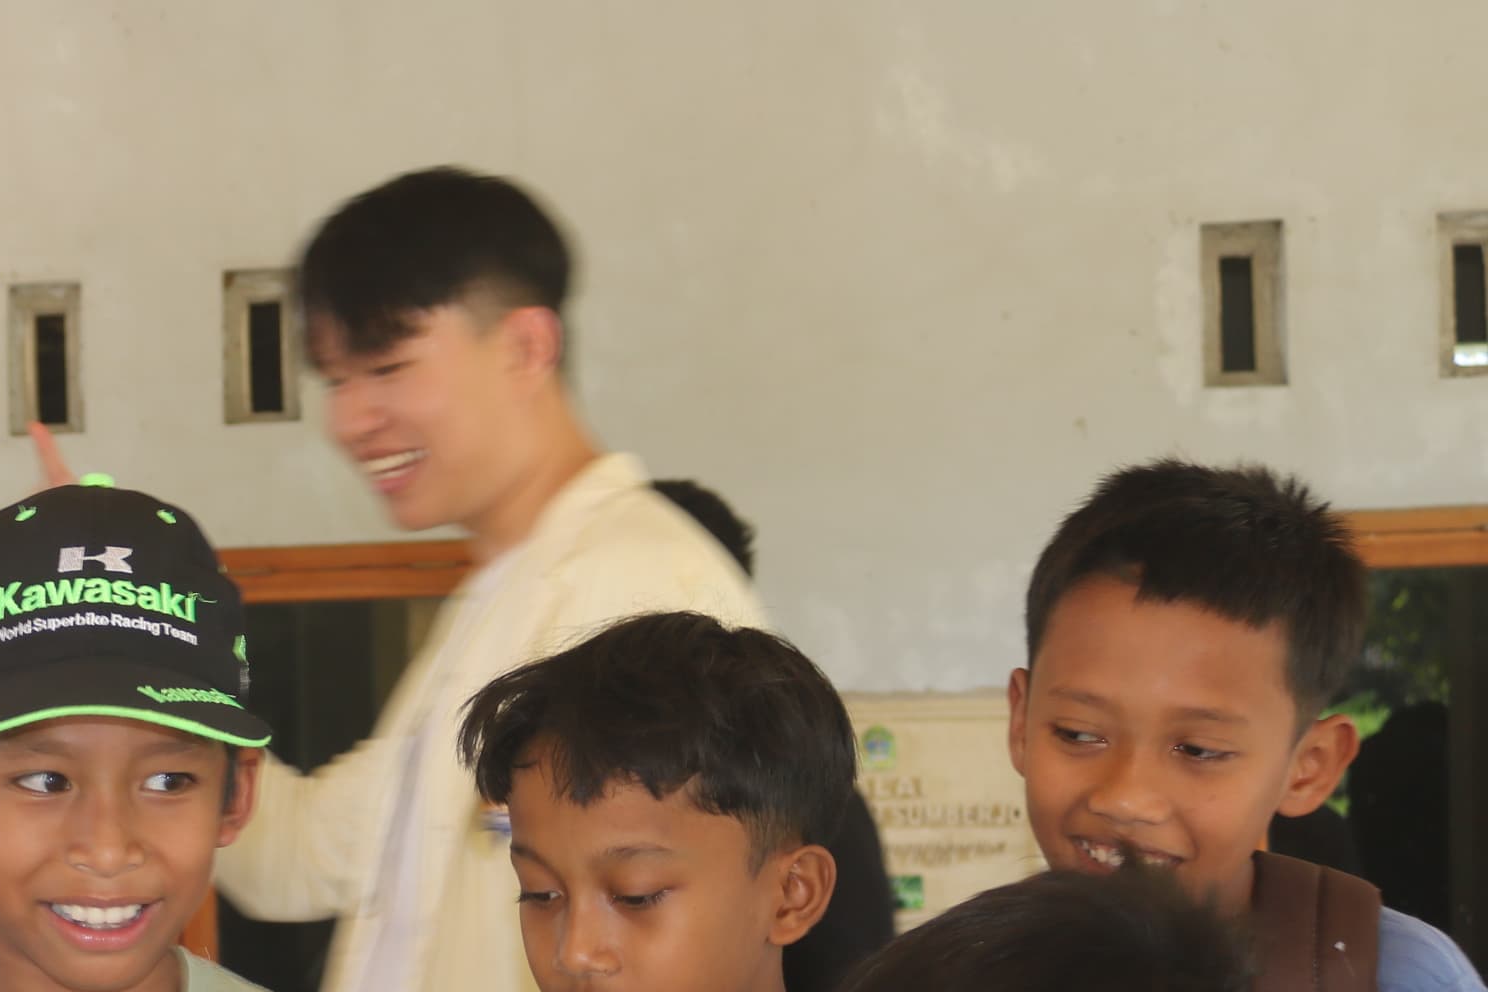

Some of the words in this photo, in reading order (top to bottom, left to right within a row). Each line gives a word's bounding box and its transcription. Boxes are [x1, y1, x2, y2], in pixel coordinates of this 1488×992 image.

[31, 612, 110, 634] Superbike
[111, 612, 161, 636] Racing
[160, 622, 198, 646] Team
